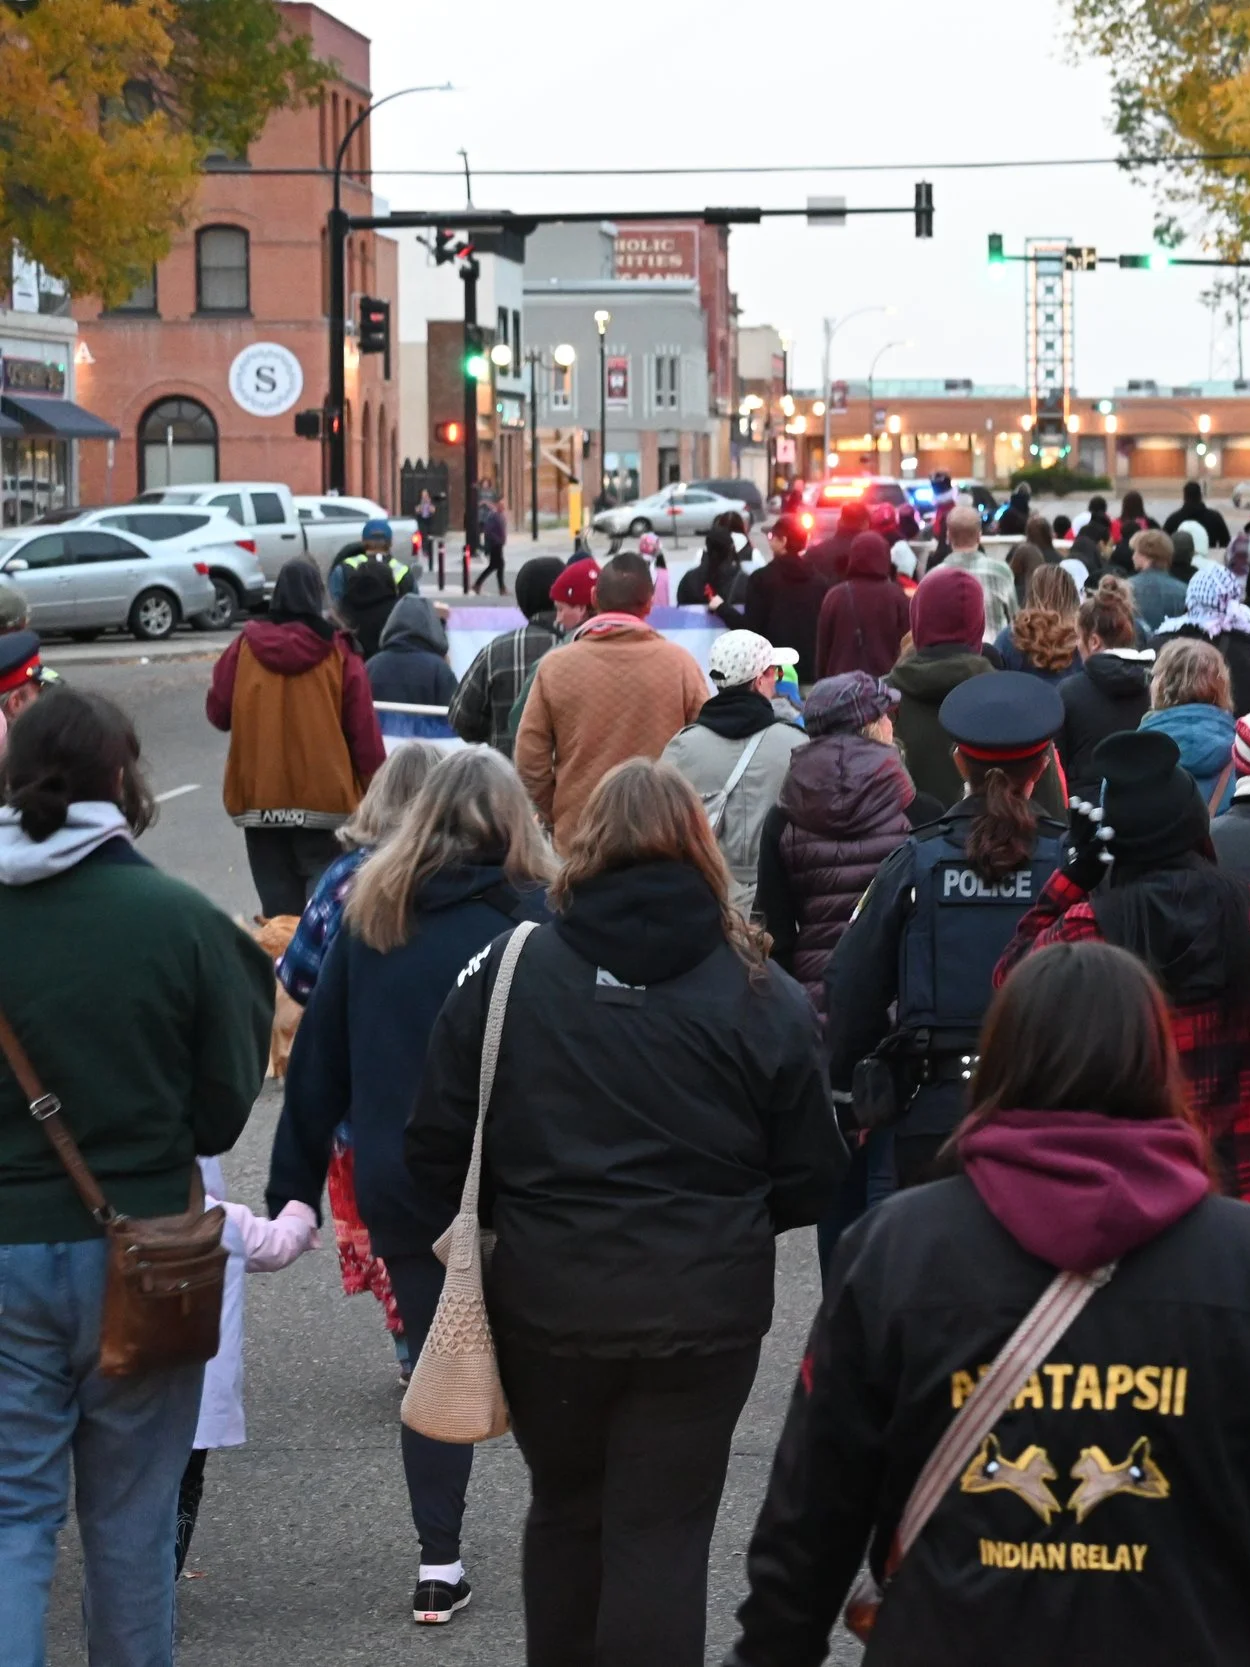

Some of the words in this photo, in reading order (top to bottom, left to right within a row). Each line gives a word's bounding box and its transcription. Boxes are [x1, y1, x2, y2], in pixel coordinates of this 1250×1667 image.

[255, 365, 277, 393] S
[980, 1538, 1066, 1571] INDIAN
[1070, 1542, 1147, 1572] RELAY
